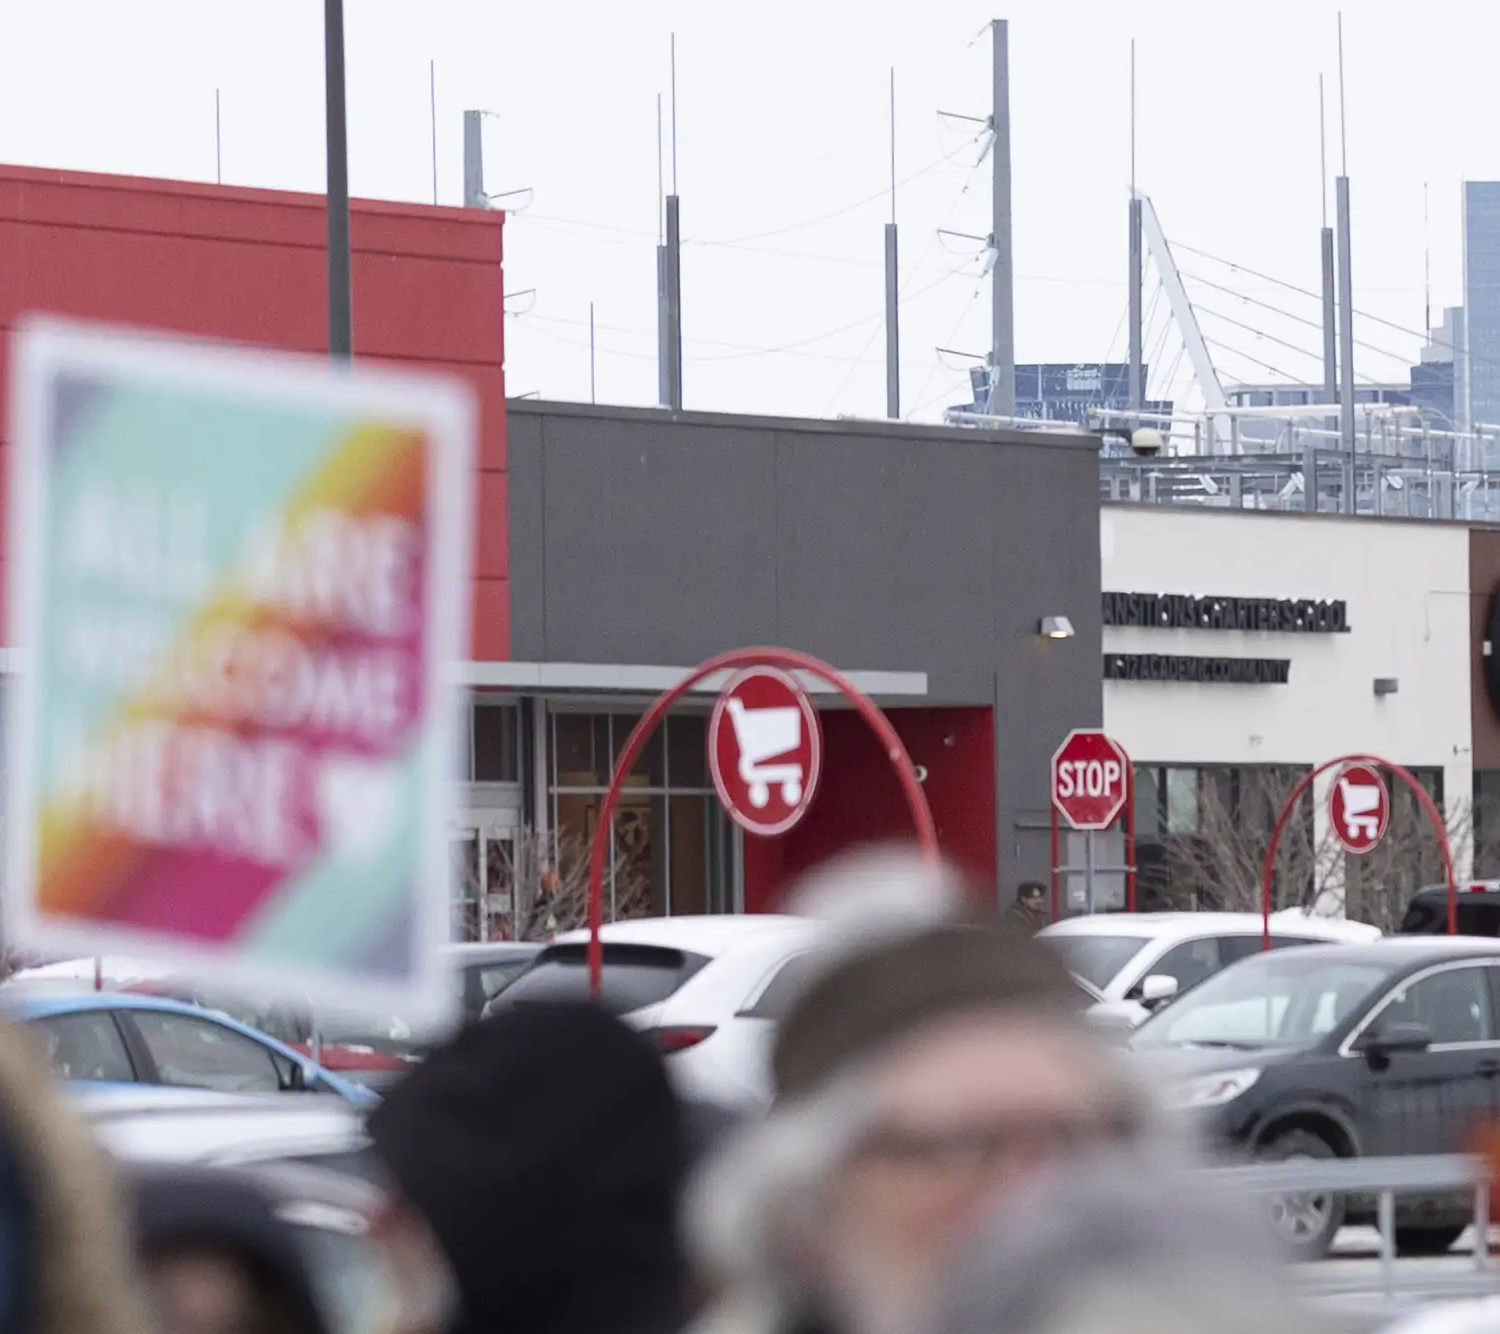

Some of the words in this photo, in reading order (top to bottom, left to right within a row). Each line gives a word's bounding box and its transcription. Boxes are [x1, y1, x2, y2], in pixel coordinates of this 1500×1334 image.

[66, 475, 210, 572] ALL
[1198, 596, 1280, 631] CHARTER
[1279, 599, 1351, 633] SCHOOL
[66, 613, 416, 732] WELCOME
[1058, 760, 1120, 797] STOP
